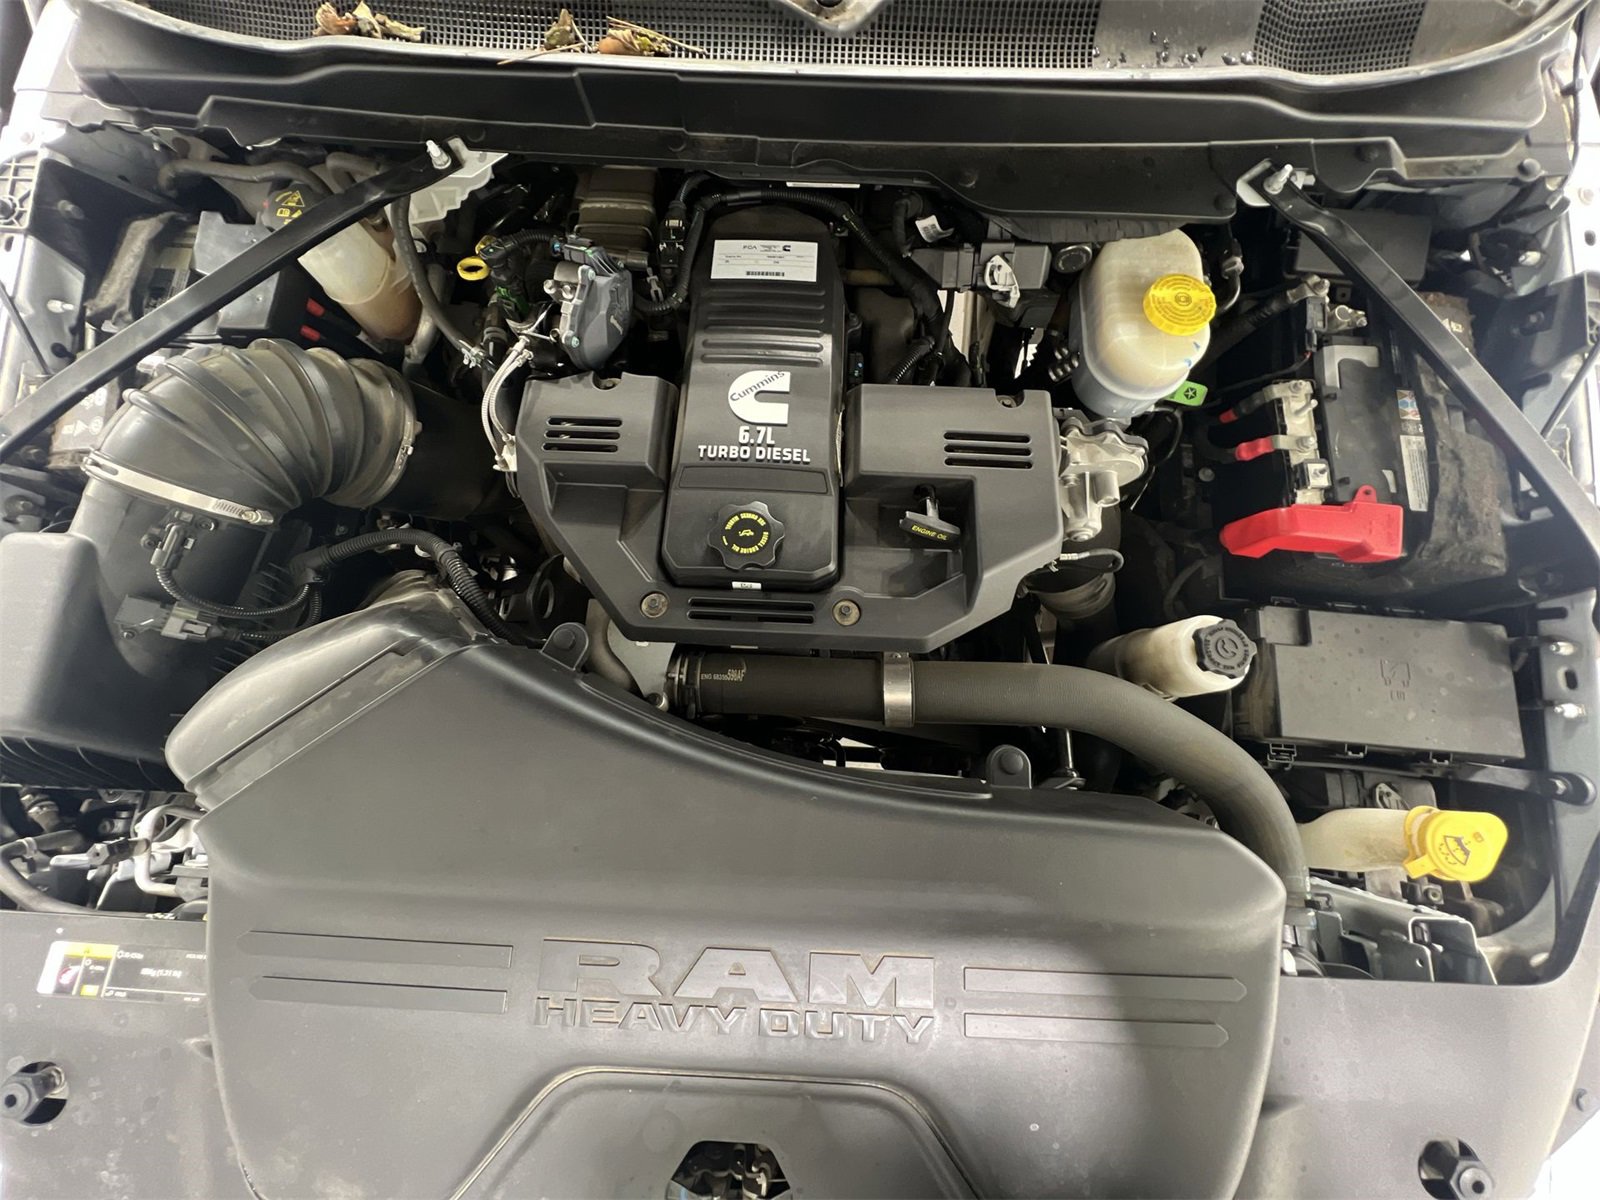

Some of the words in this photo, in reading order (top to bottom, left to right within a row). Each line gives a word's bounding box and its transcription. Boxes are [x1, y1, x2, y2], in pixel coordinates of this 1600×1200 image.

[729, 371, 785, 402] Cummins
[738, 425, 776, 446] 6.7L
[698, 445, 751, 460] TURBO
[755, 446, 811, 463] DIESEL
[912, 525, 936, 536] ENGINE
[537, 937, 935, 1009] RAM
[533, 996, 748, 1036] HEAVY
[758, 1007, 936, 1045] DUTY
